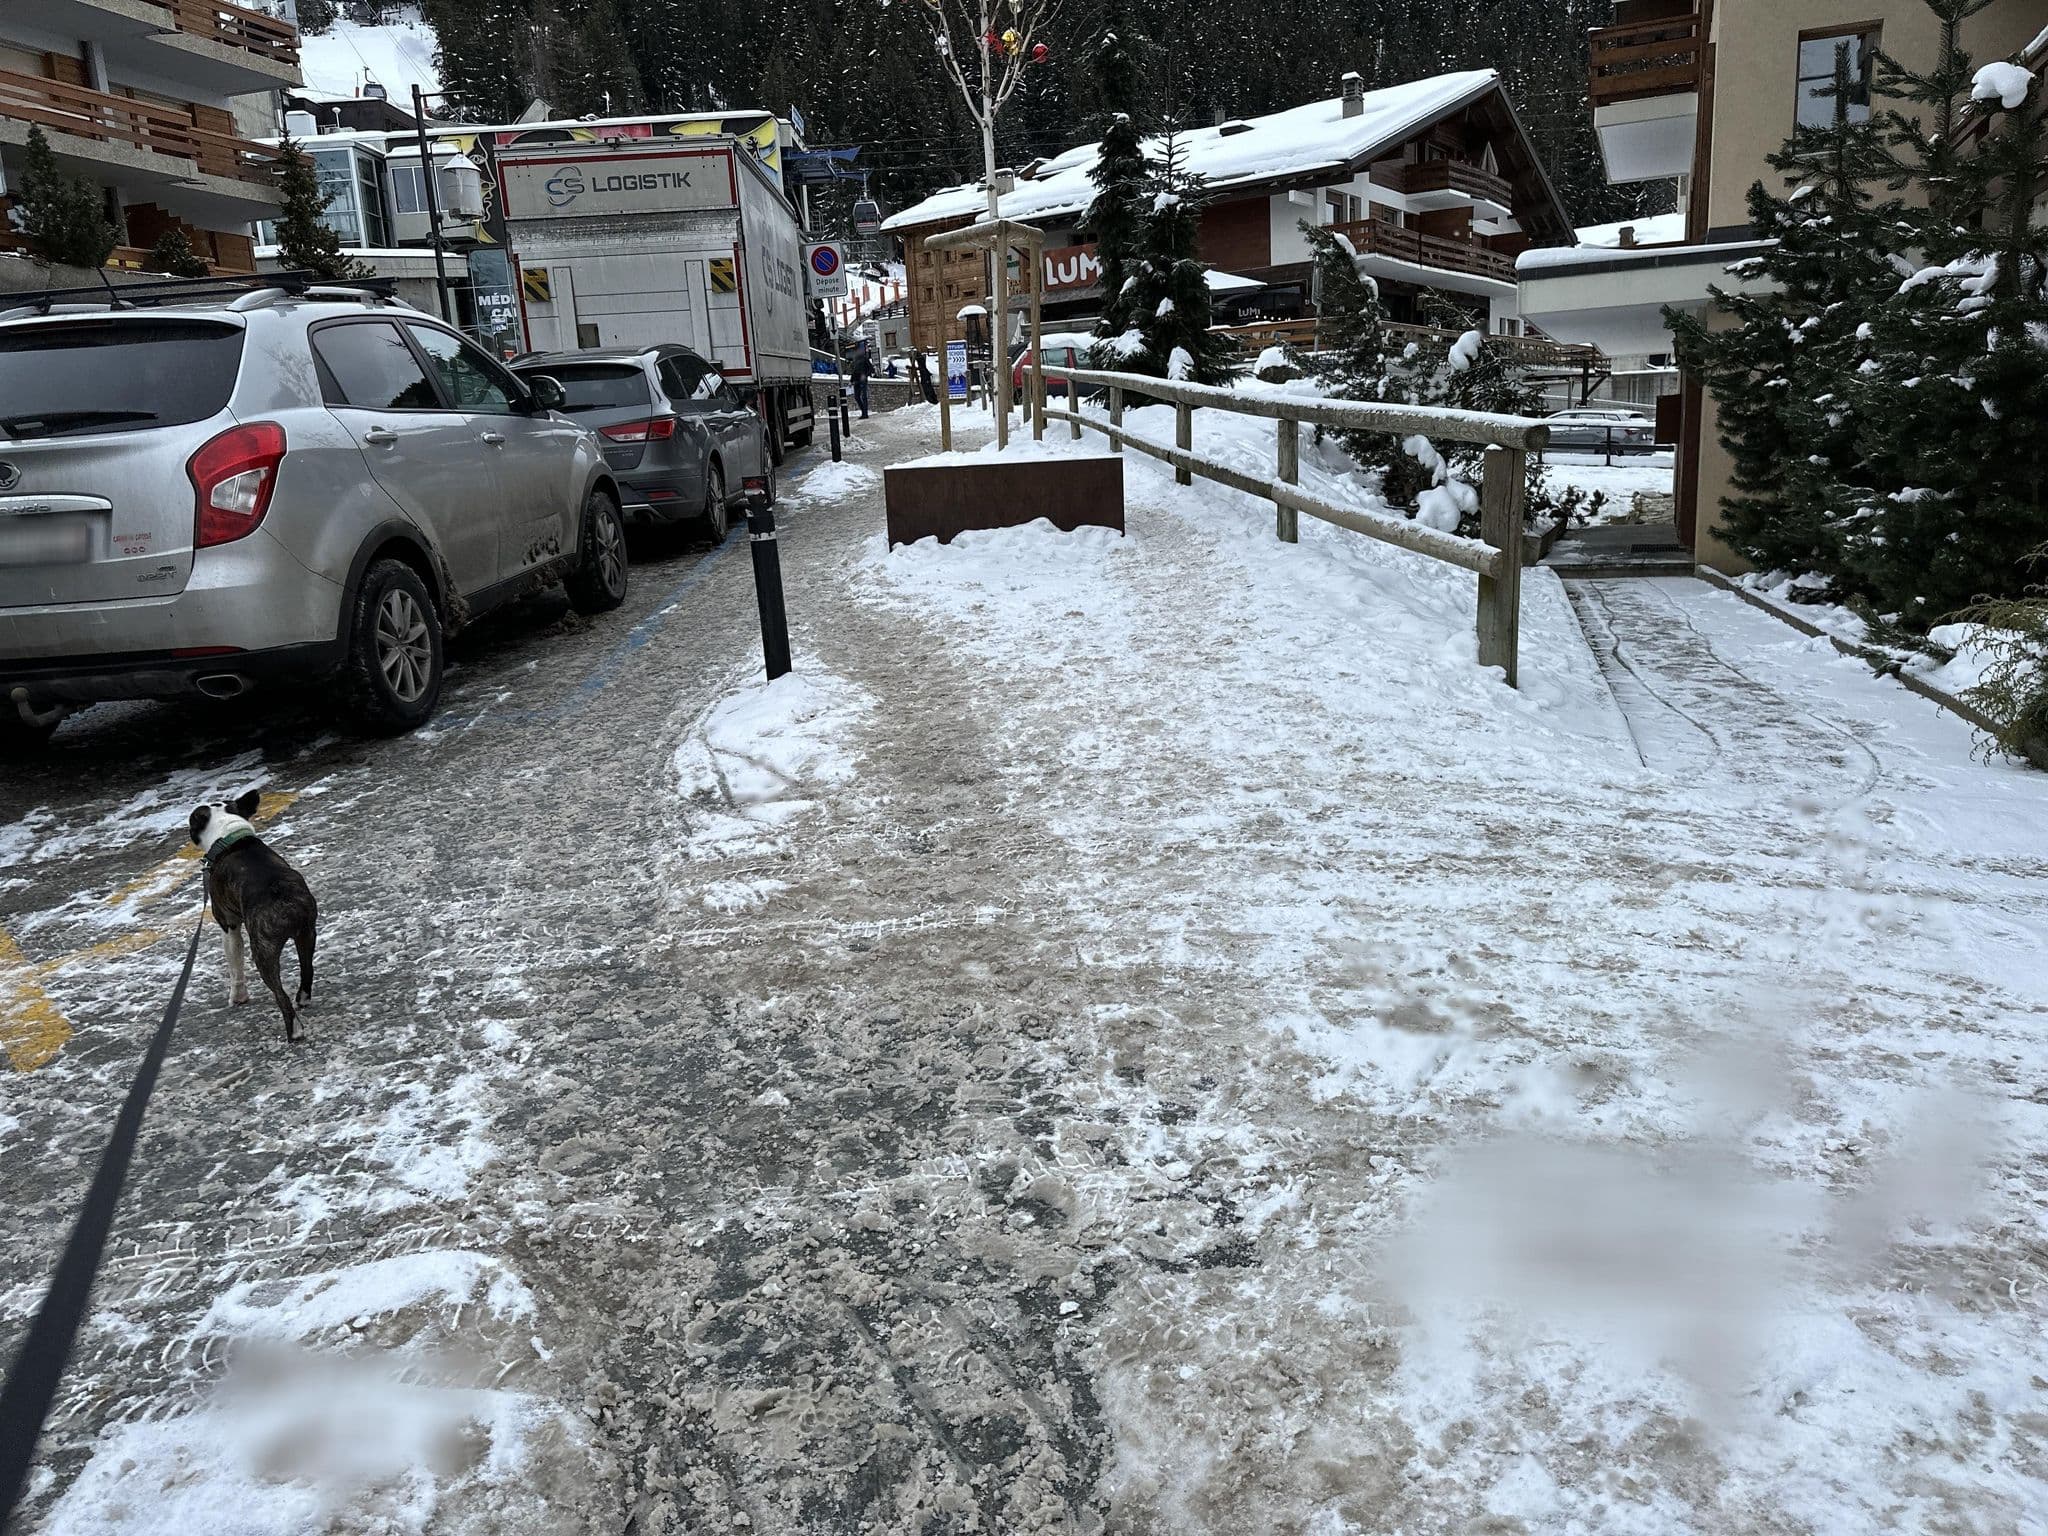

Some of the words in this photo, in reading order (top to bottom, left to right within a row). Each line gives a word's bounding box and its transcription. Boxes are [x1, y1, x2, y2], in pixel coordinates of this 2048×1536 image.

[544, 178, 585, 195] CS
[592, 172, 692, 192] LOGISTIK
[1045, 252, 1104, 286] LUM
[816, 278, 840, 286] Dépose
[818, 286, 840, 294] minute
[1238, 307, 1261, 318] LUMI
